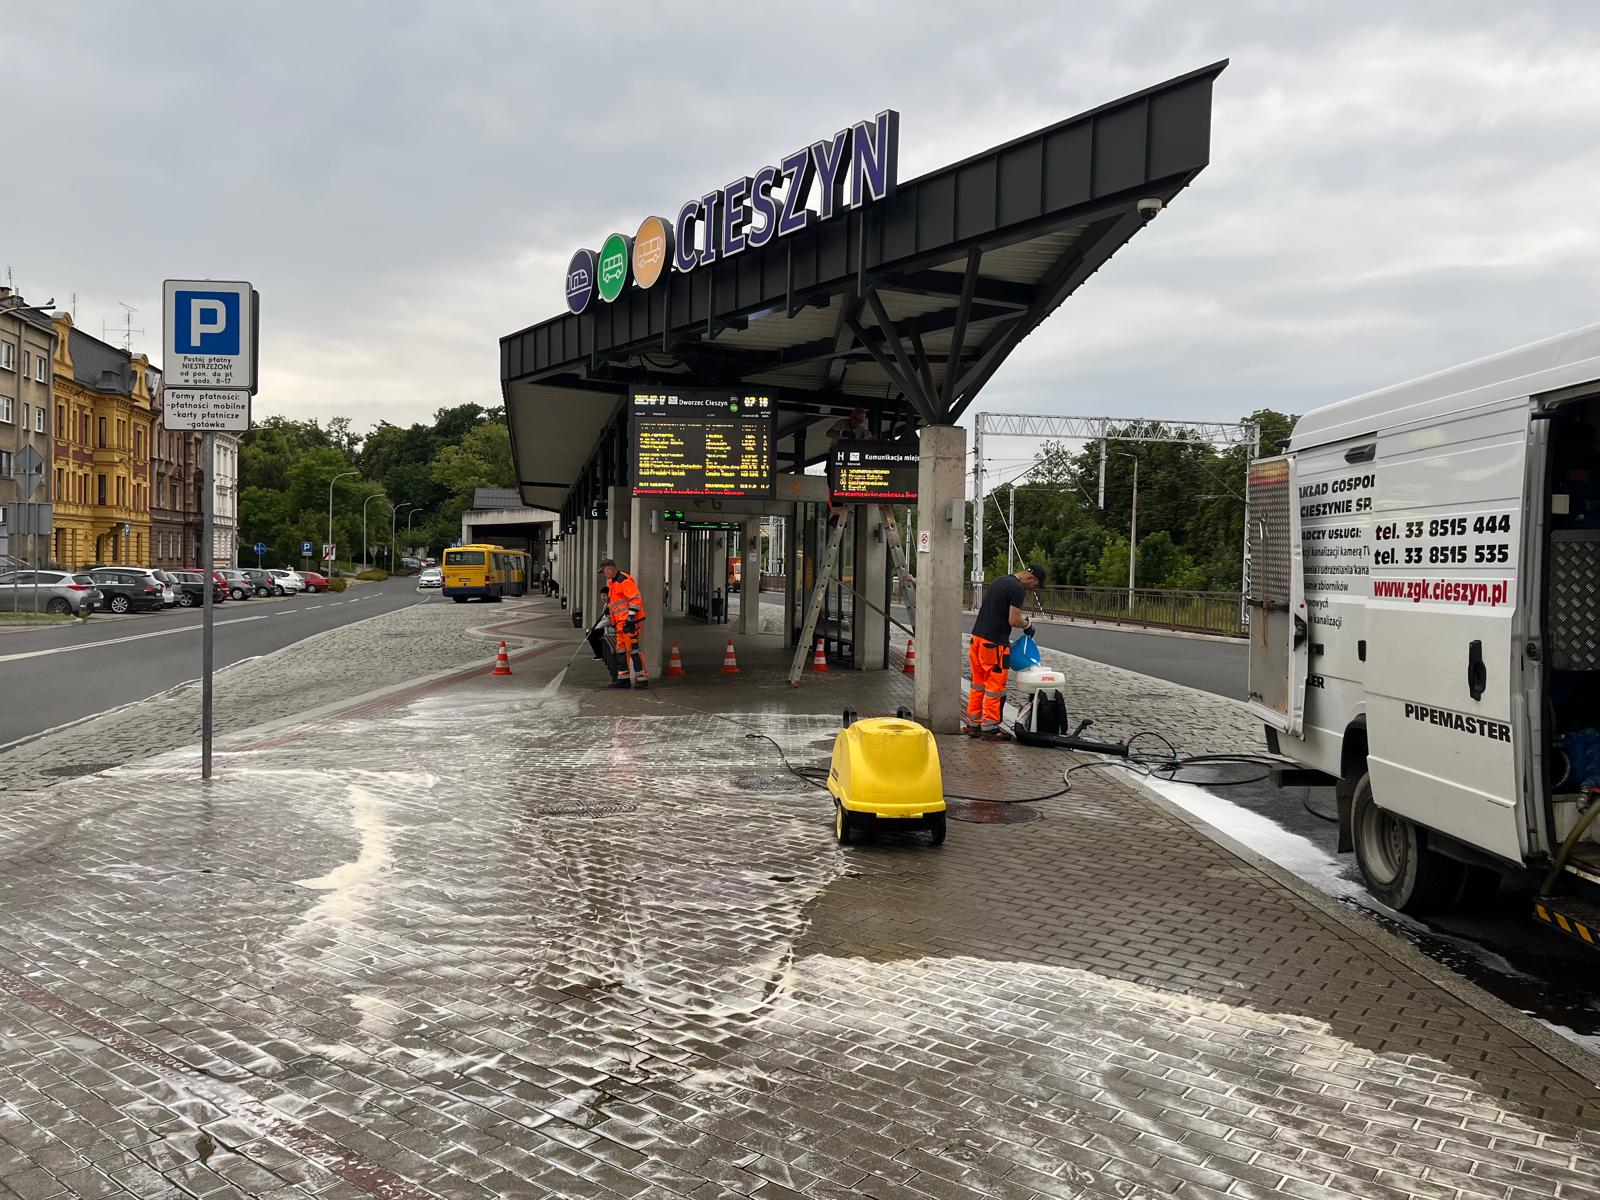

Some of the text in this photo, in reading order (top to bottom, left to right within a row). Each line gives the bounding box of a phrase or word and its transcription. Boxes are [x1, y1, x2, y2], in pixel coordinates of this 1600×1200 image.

[674, 109, 898, 273] CIESZYN
[191, 298, 227, 347] P
[208, 356, 231, 364] płatny
[171, 392, 195, 401] Formy
[705, 399, 728, 407] Cieszyn
[173, 411, 240, 420] -karty płatnicze
[187, 421, 226, 429] -gotówka
[837, 451, 845, 461] H
[865, 454, 903, 462] Komunikacja
[591, 508, 598, 516] G
[1301, 497, 1372, 518] CIESZYNIE SP.
[1328, 527, 1361, 540] USŁUGI:
[1375, 514, 1511, 540] tel. 33 8515 444
[1311, 546, 1340, 559] kanalizacji
[1374, 544, 1509, 565] tel. 33 8515 535
[1374, 579, 1508, 607] www.zgk.cieszyn.pl
[1404, 703, 1511, 743] PIPEMASTER
